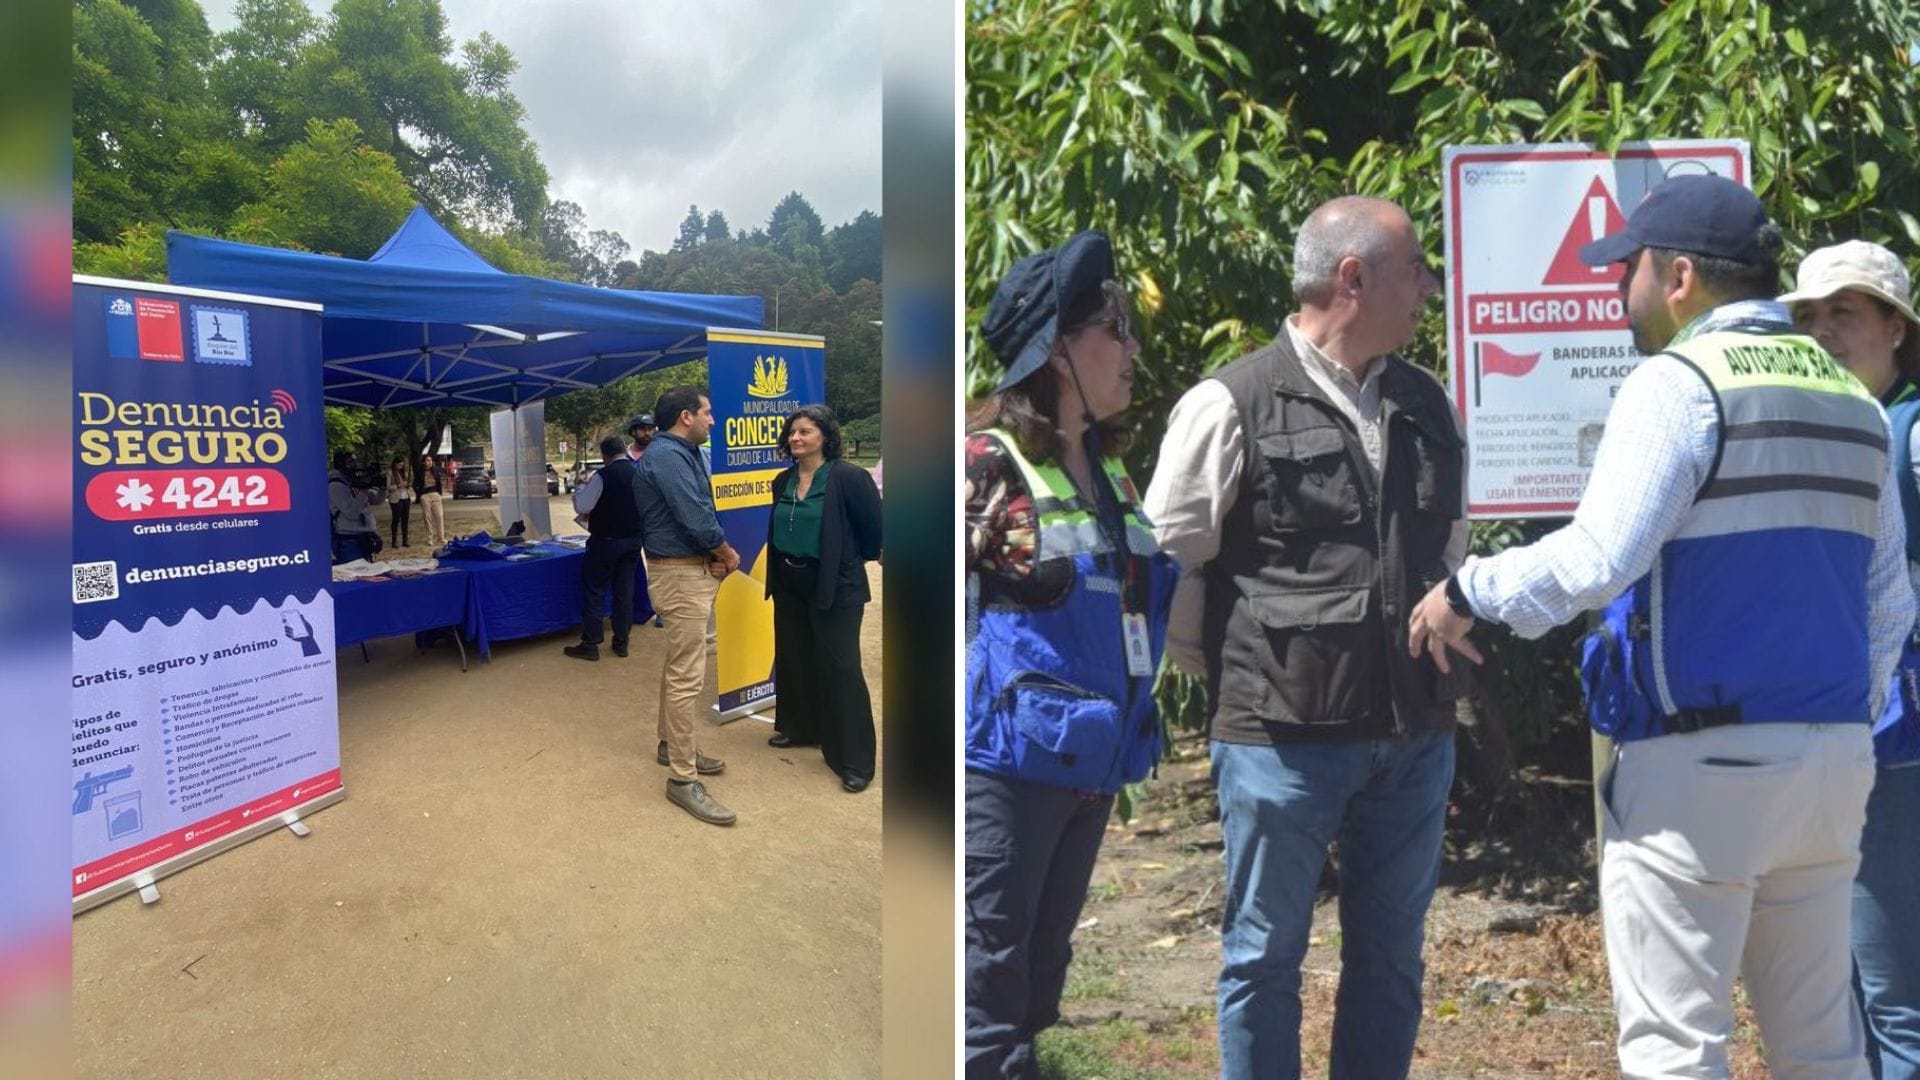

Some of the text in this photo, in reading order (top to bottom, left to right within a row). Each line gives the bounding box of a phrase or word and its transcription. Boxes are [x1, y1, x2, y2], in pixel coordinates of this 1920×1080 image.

[1475, 298, 1624, 325] PELIGRO NO
[1552, 346, 1625, 361] BANDERAS
[1722, 345, 1809, 378] AUTORIDAD
[79, 392, 284, 430] Denuncia
[743, 400, 792, 414] MUNICIPALIDAD
[725, 416, 785, 447] CONCEP
[1475, 429, 1504, 439] FECHA
[80, 429, 288, 466] SEGURO
[727, 451, 752, 466] CIUDAD
[752, 450, 761, 464] DE
[762, 449, 773, 463] LA
[1513, 474, 1584, 485] IMPORTANTE
[715, 481, 754, 499] DIRECCIÓN
[755, 481, 765, 494] DE
[1485, 488, 1516, 500] USAR
[1517, 487, 1581, 499] ELEMENTOS
[133, 519, 259, 535] Gratis desde celulares
[126, 550, 310, 584] denunciaseguro.cl
[72, 638, 278, 689] Gratis, seguro y anónimo
[747, 682, 775, 701] EJÉRCITO
[172, 701, 201, 712] Tráfico
[214, 691, 239, 703] drogas
[72, 710, 121, 728] ipos de
[173, 708, 211, 721] Violencia
[174, 720, 204, 732] Bandas
[211, 709, 245, 723] personas
[245, 698, 280, 712] dedicadas
[288, 692, 303, 700] robo
[175, 727, 214, 741] Comercio
[275, 702, 296, 713] bienes
[114, 720, 138, 732] que
[176, 735, 221, 752] Homicidios
[214, 744, 223, 752] de
[232, 734, 259, 747] justicia
[178, 761, 205, 773] Delitos
[207, 750, 238, 764] sexuales
[238, 743, 262, 753] contra
[179, 773, 199, 783] Robo
[180, 755, 277, 793] Placas patentes adulteradas
[181, 791, 201, 802] Trata
[213, 776, 245, 792] personas
[182, 793, 223, 812] Entre otros
